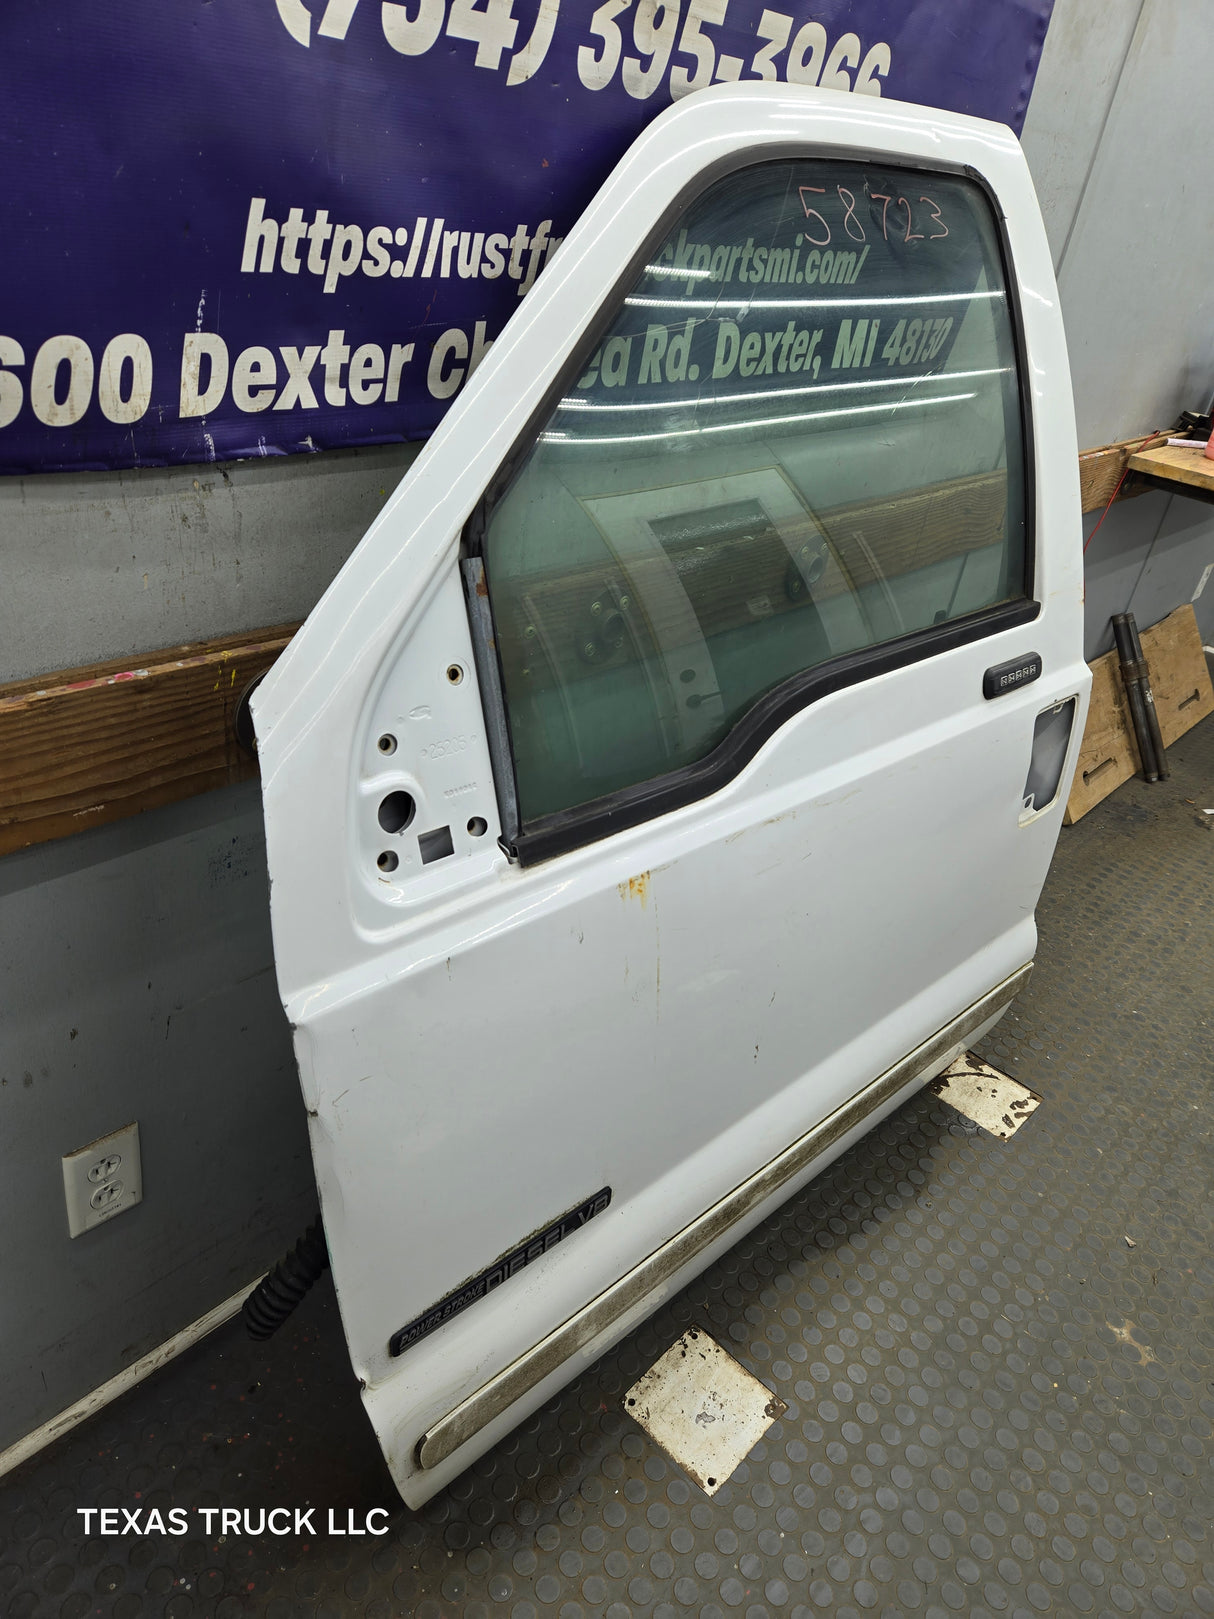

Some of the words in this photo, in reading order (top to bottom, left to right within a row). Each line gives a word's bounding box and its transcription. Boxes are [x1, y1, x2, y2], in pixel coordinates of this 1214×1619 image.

[799, 184, 949, 246] 58723
[179, 330, 415, 418] Dexter
[638, 317, 700, 384] Rd.
[712, 320, 823, 380] Dexter,
[831, 319, 881, 369] MI
[882, 317, 954, 367] 48130
[400, 1311, 443, 1348] POWER
[443, 1281, 486, 1318] STROKE
[486, 1223, 576, 1294] DIESEL
[578, 1195, 608, 1226] V8
